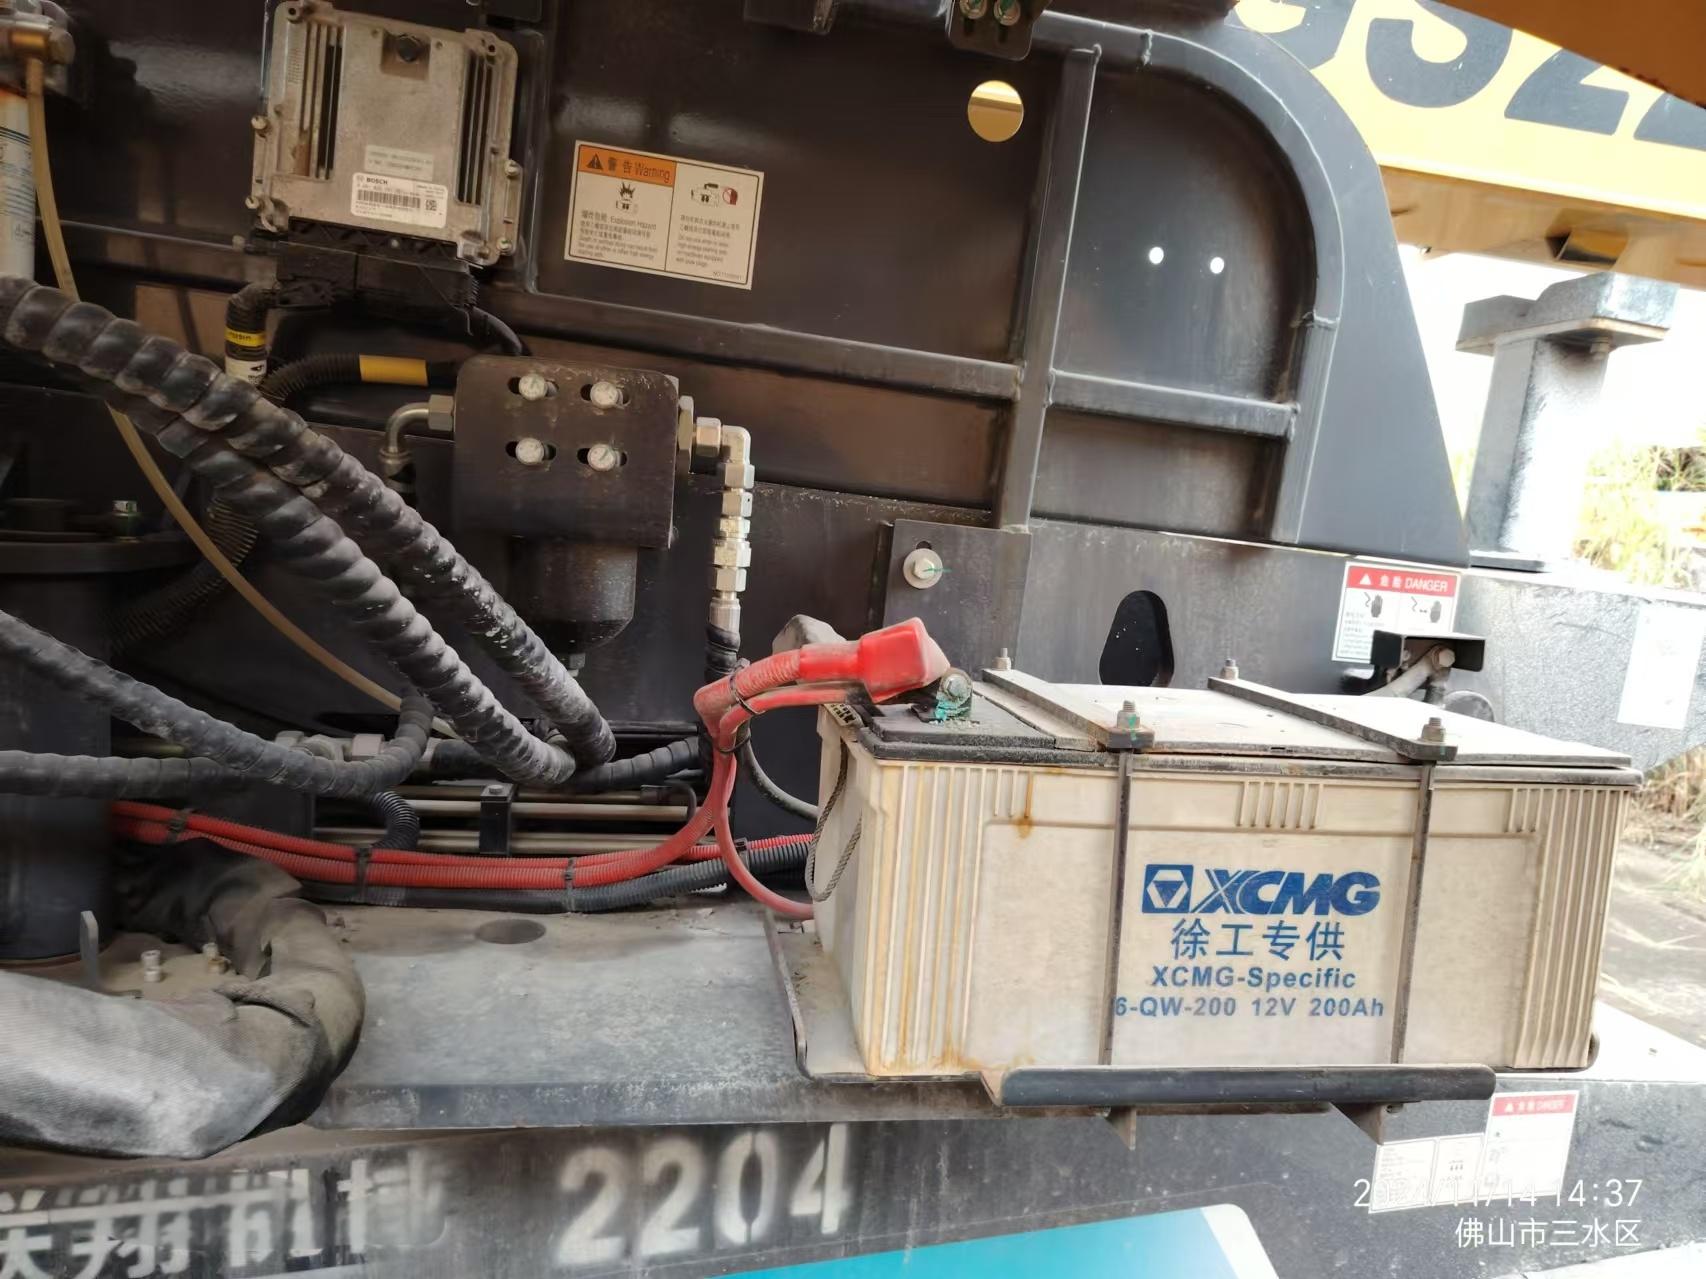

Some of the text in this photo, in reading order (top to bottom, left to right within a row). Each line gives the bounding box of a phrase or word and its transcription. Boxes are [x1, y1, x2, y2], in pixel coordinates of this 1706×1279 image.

[366, 176, 388, 186] BOSCH
[634, 161, 671, 183] Warning
[1404, 577, 1448, 593] DANGER
[1190, 868, 1381, 916] XCMG
[1170, 917, 1345, 961] 徐工专供
[1152, 965, 1356, 993] XCMG-Specific
[1115, 996, 1385, 1017] 6-QW-200 12V 200Ah
[556, 1122, 851, 1265] 2204
